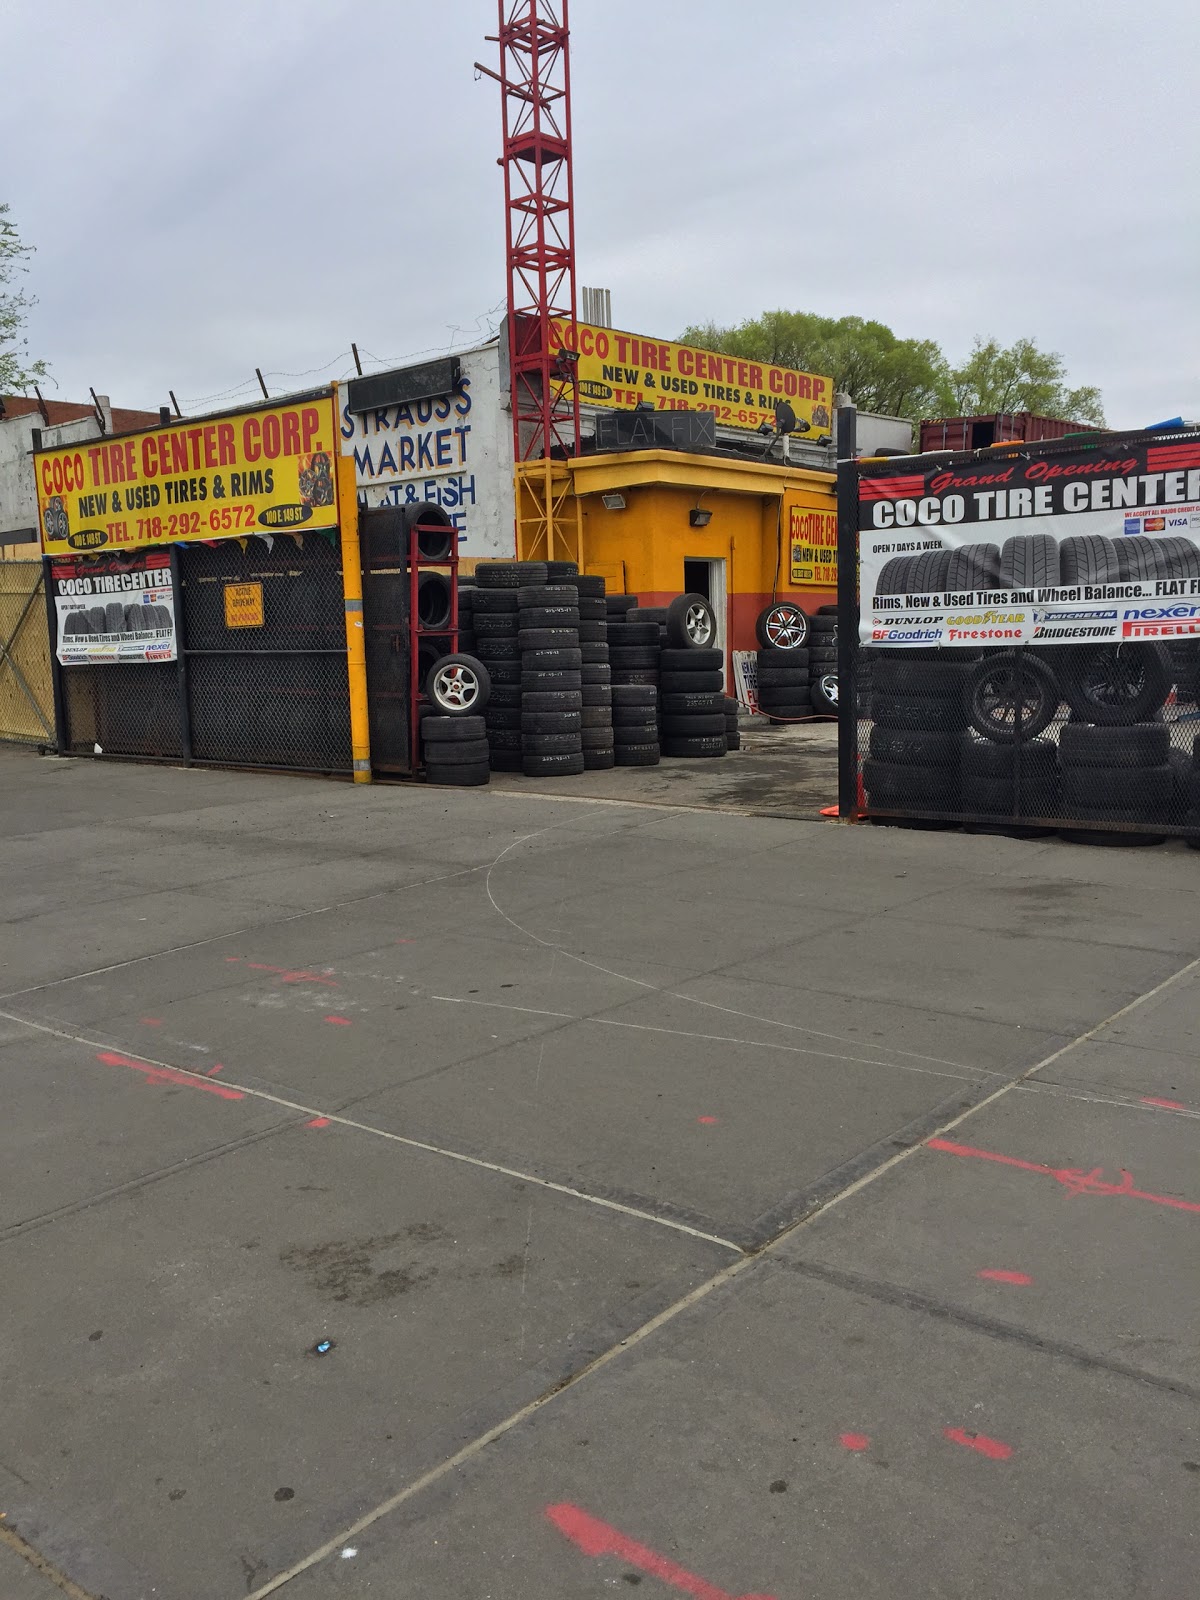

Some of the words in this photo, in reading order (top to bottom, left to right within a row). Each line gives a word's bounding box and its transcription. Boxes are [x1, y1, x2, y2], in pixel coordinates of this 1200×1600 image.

[548, 322, 609, 359] COCO
[614, 335, 671, 372] TIRE
[678, 350, 763, 390] CENTER
[769, 369, 826, 402] CORP.
[602, 364, 639, 385] NEW
[644, 372, 656, 388] &
[661, 375, 698, 395] USED
[703, 383, 740, 404] TIRES
[745, 391, 754, 406] &
[600, 416, 660, 445] FLAT
[672, 415, 713, 443] FIX
[42, 453, 84, 496] COCO
[88, 441, 137, 487] TIRE
[142, 423, 236, 478] CENTER
[243, 408, 322, 462] CORP.
[354, 425, 471, 476] MARKET
[405, 483, 419, 504] &
[424, 475, 476, 507] FISH
[930, 466, 1014, 495] Grand
[1025, 458, 1140, 482] Opening
[78, 492, 107, 518] NEW
[112, 490, 122, 513] &
[126, 484, 160, 511] USED
[165, 476, 207, 504] TIRES
[213, 474, 226, 499] &
[231, 468, 274, 497] RIMS
[872, 494, 965, 528] COCO
[973, 485, 1053, 520] TIRE
[106, 521, 133, 544] TEL.
[137, 504, 256, 540] 718-292-6572
[283, 507, 294, 522] 149
[791, 514, 808, 540] COCO
[808, 513, 824, 546] TIRE
[1168, 518, 1188, 526] VISA
[802, 547, 814, 562] NEW
[820, 549, 832, 564] USED
[872, 543, 890, 553] OPEN
[891, 543, 896, 552] 7
[896, 542, 915, 552] DAYS
[916, 541, 921, 550] A
[922, 540, 943, 550] WEEK
[58, 577, 92, 596] COCO
[93, 574, 121, 593] TIRE
[121, 568, 173, 591] CENTER
[872, 597, 903, 610] Rims,
[906, 595, 930, 608] New
[932, 596, 941, 607] &
[944, 594, 973, 607] Used
[977, 591, 1008, 605] Tires
[1011, 590, 1034, 604] and
[1038, 587, 1081, 602] Wheel
[1084, 584, 1152, 600] Balance...
[1155, 580, 1187, 596] FLAT
[872, 629, 943, 640] BFGoodrich
[949, 629, 1023, 641] Firestone
[1033, 625, 1118, 639] BRIDGESTONE
[883, 616, 944, 626] DUNLOP
[946, 610, 1025, 626] GOODYEAR
[1049, 611, 1115, 620] MICHELIN
